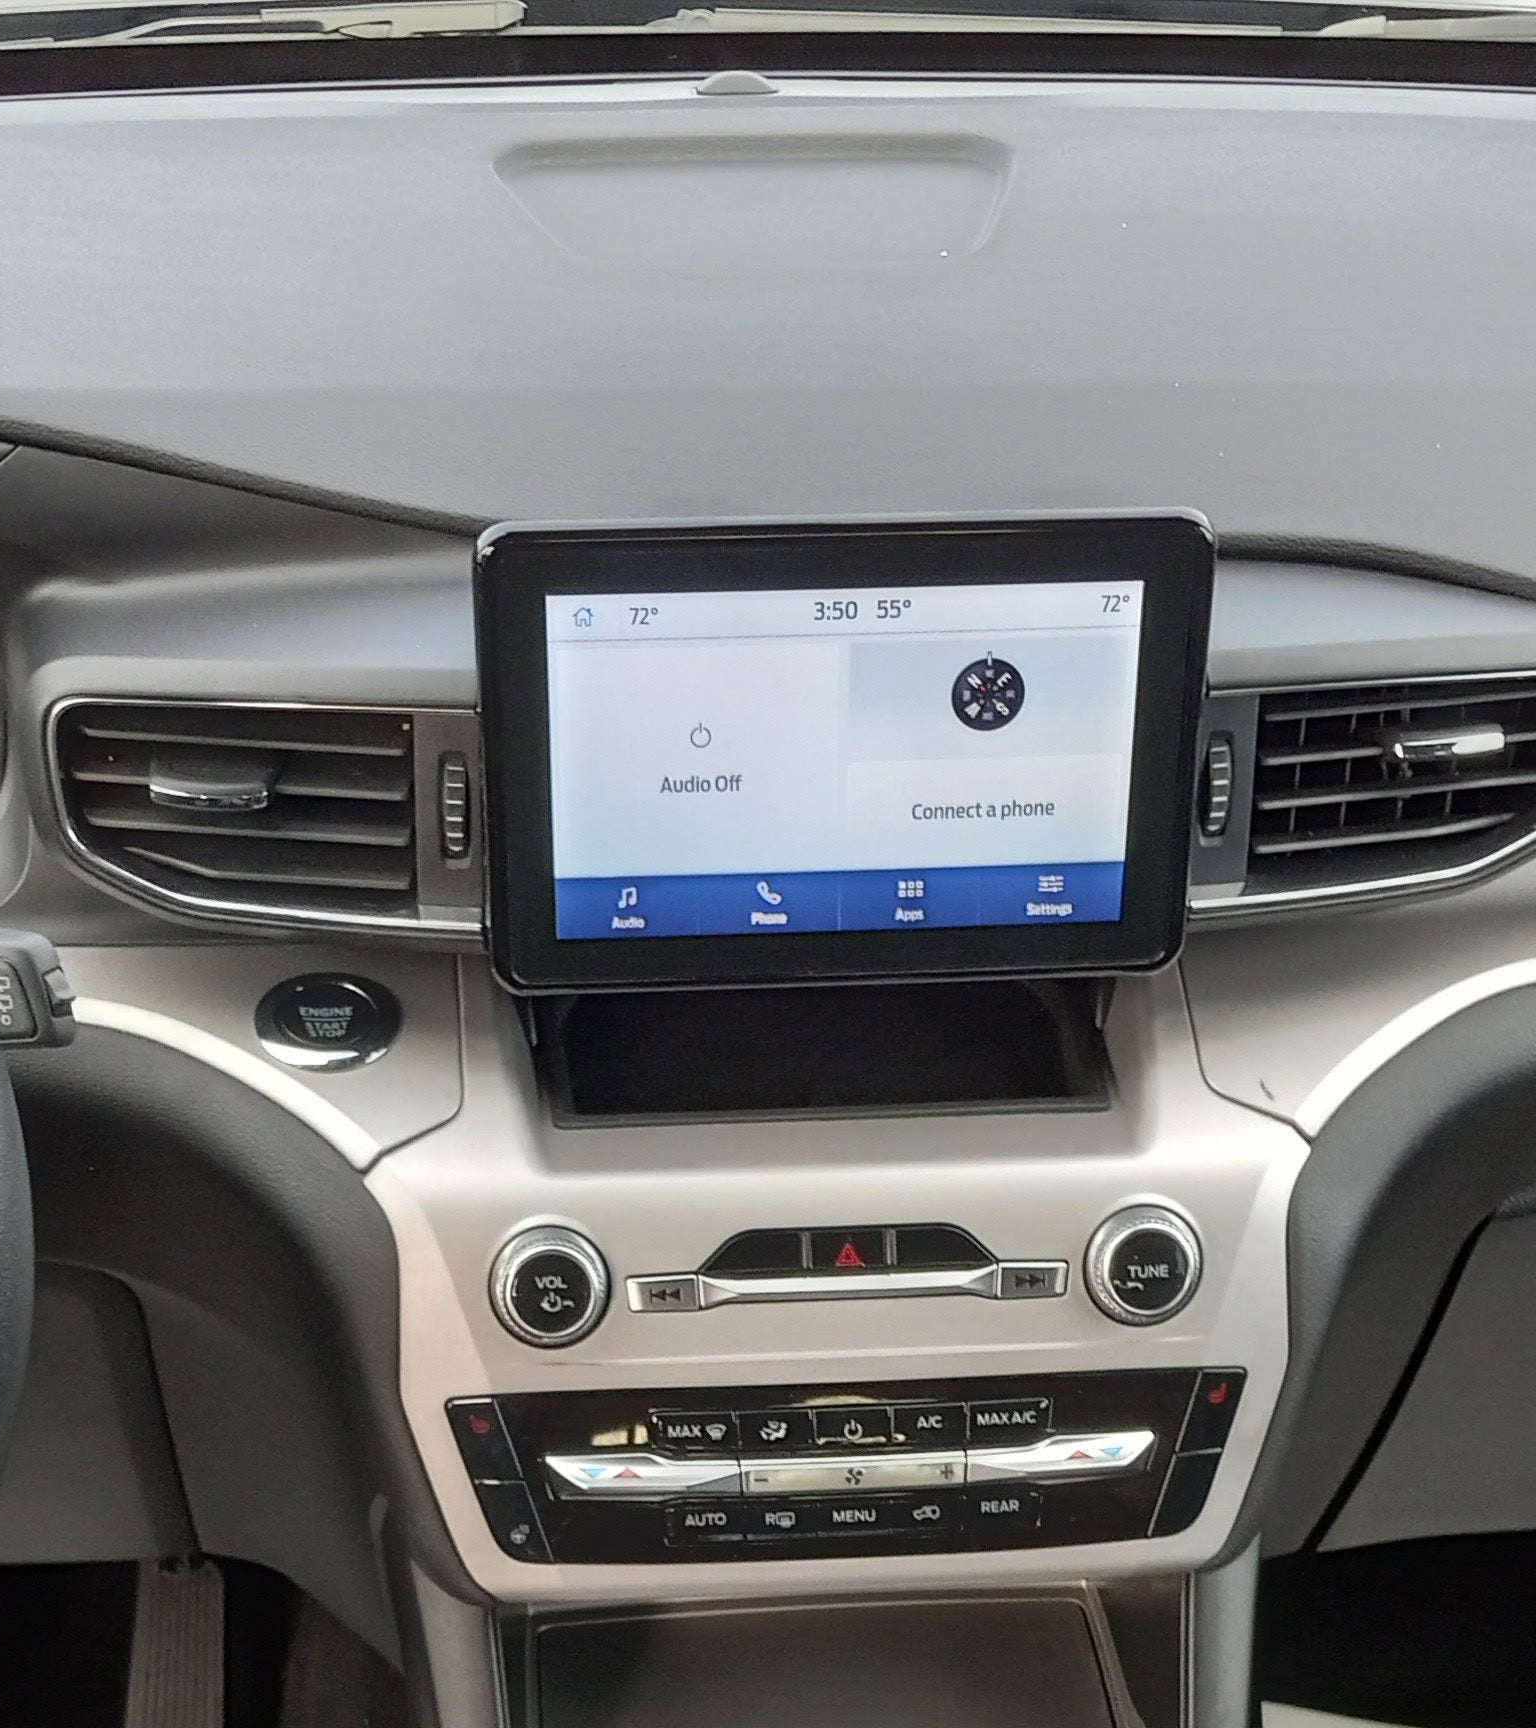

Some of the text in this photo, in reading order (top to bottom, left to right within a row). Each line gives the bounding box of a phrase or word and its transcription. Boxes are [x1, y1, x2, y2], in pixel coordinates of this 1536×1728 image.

[814, 602, 859, 622] 3:50
[876, 600, 912, 619] 55°
[660, 774, 743, 795] Audio Off
[911, 799, 1055, 821] Connect a phone
[750, 910, 788, 926] Phone
[895, 907, 925, 925] Apps
[1025, 901, 1073, 919] Settings
[610, 916, 646, 931] Audio
[300, 1006, 354, 1018] ENGINE
[305, 1021, 349, 1030] START
[309, 1029, 347, 1038] STOP
[1127, 1264, 1171, 1280] TUNE
[534, 1275, 569, 1290] VOL
[916, 1414, 943, 1430] A/C
[976, 1408, 1037, 1427] MAX A/C
[667, 1424, 702, 1438] MAX
[980, 1499, 1021, 1514] REAR
[684, 1513, 728, 1527] AUTO
[832, 1508, 877, 1523] MENU
